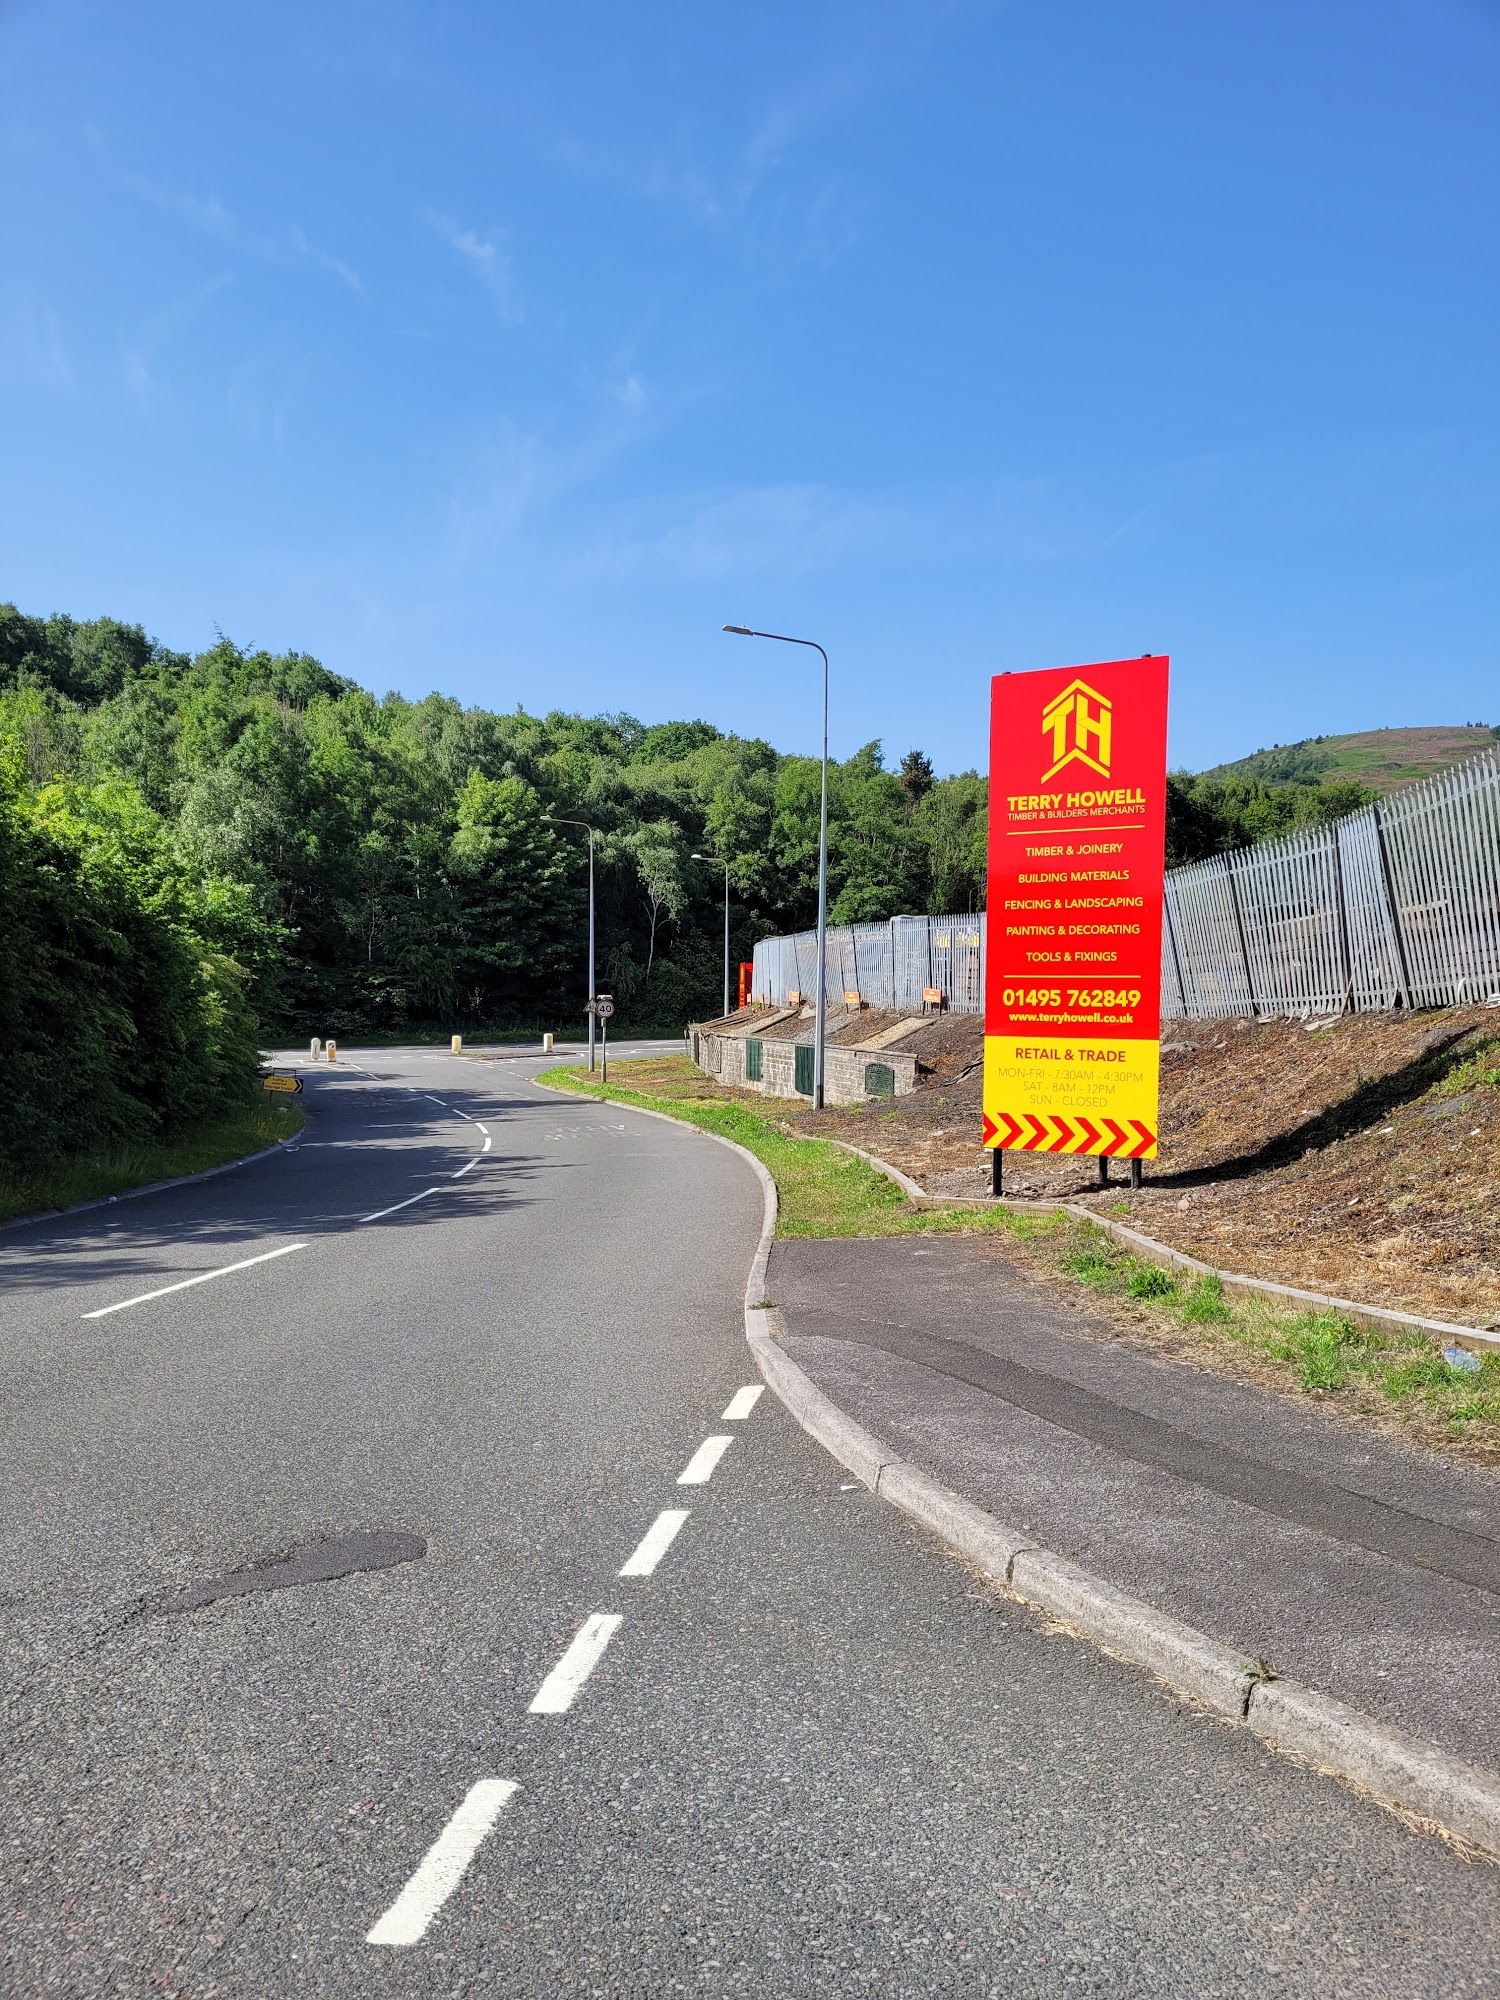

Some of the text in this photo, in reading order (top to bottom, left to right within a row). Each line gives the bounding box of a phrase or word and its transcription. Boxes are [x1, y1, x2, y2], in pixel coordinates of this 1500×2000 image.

[1007, 788, 1146, 812] TERRY HOWELL
[1007, 804, 1146, 821] TIMBER & BUILDERS MERCHANTS
[1025, 843, 1123, 857] TIMBER & JOINERY
[1018, 869, 1130, 884] BUILDING MATERIALS
[1004, 897, 1144, 910] FENCING & LANDSCAPING
[1006, 924, 1141, 936] PAINTING & DECORATING
[1026, 951, 1118, 962] TOOLS & FIXINGS
[1002, 988, 1142, 1008] 01495 762849
[599, 1005, 612, 1013] 40
[1008, 1012, 1134, 1025] www.terryhowell.co.uk
[1015, 1047, 1127, 1063] RETAIL & TRADE
[998, 1067, 1045, 1079] MON-FRI
[1055, 1069, 1094, 1081] 7:30AM
[1103, 1071, 1144, 1083] 4:30PM
[1023, 1081, 1043, 1091] SAT
[1052, 1083, 1076, 1093] 8AM
[1087, 1084, 1116, 1095] 12PM
[1029, 1094, 1052, 1105] SUN
[1062, 1095, 1108, 1108] CLOSED
